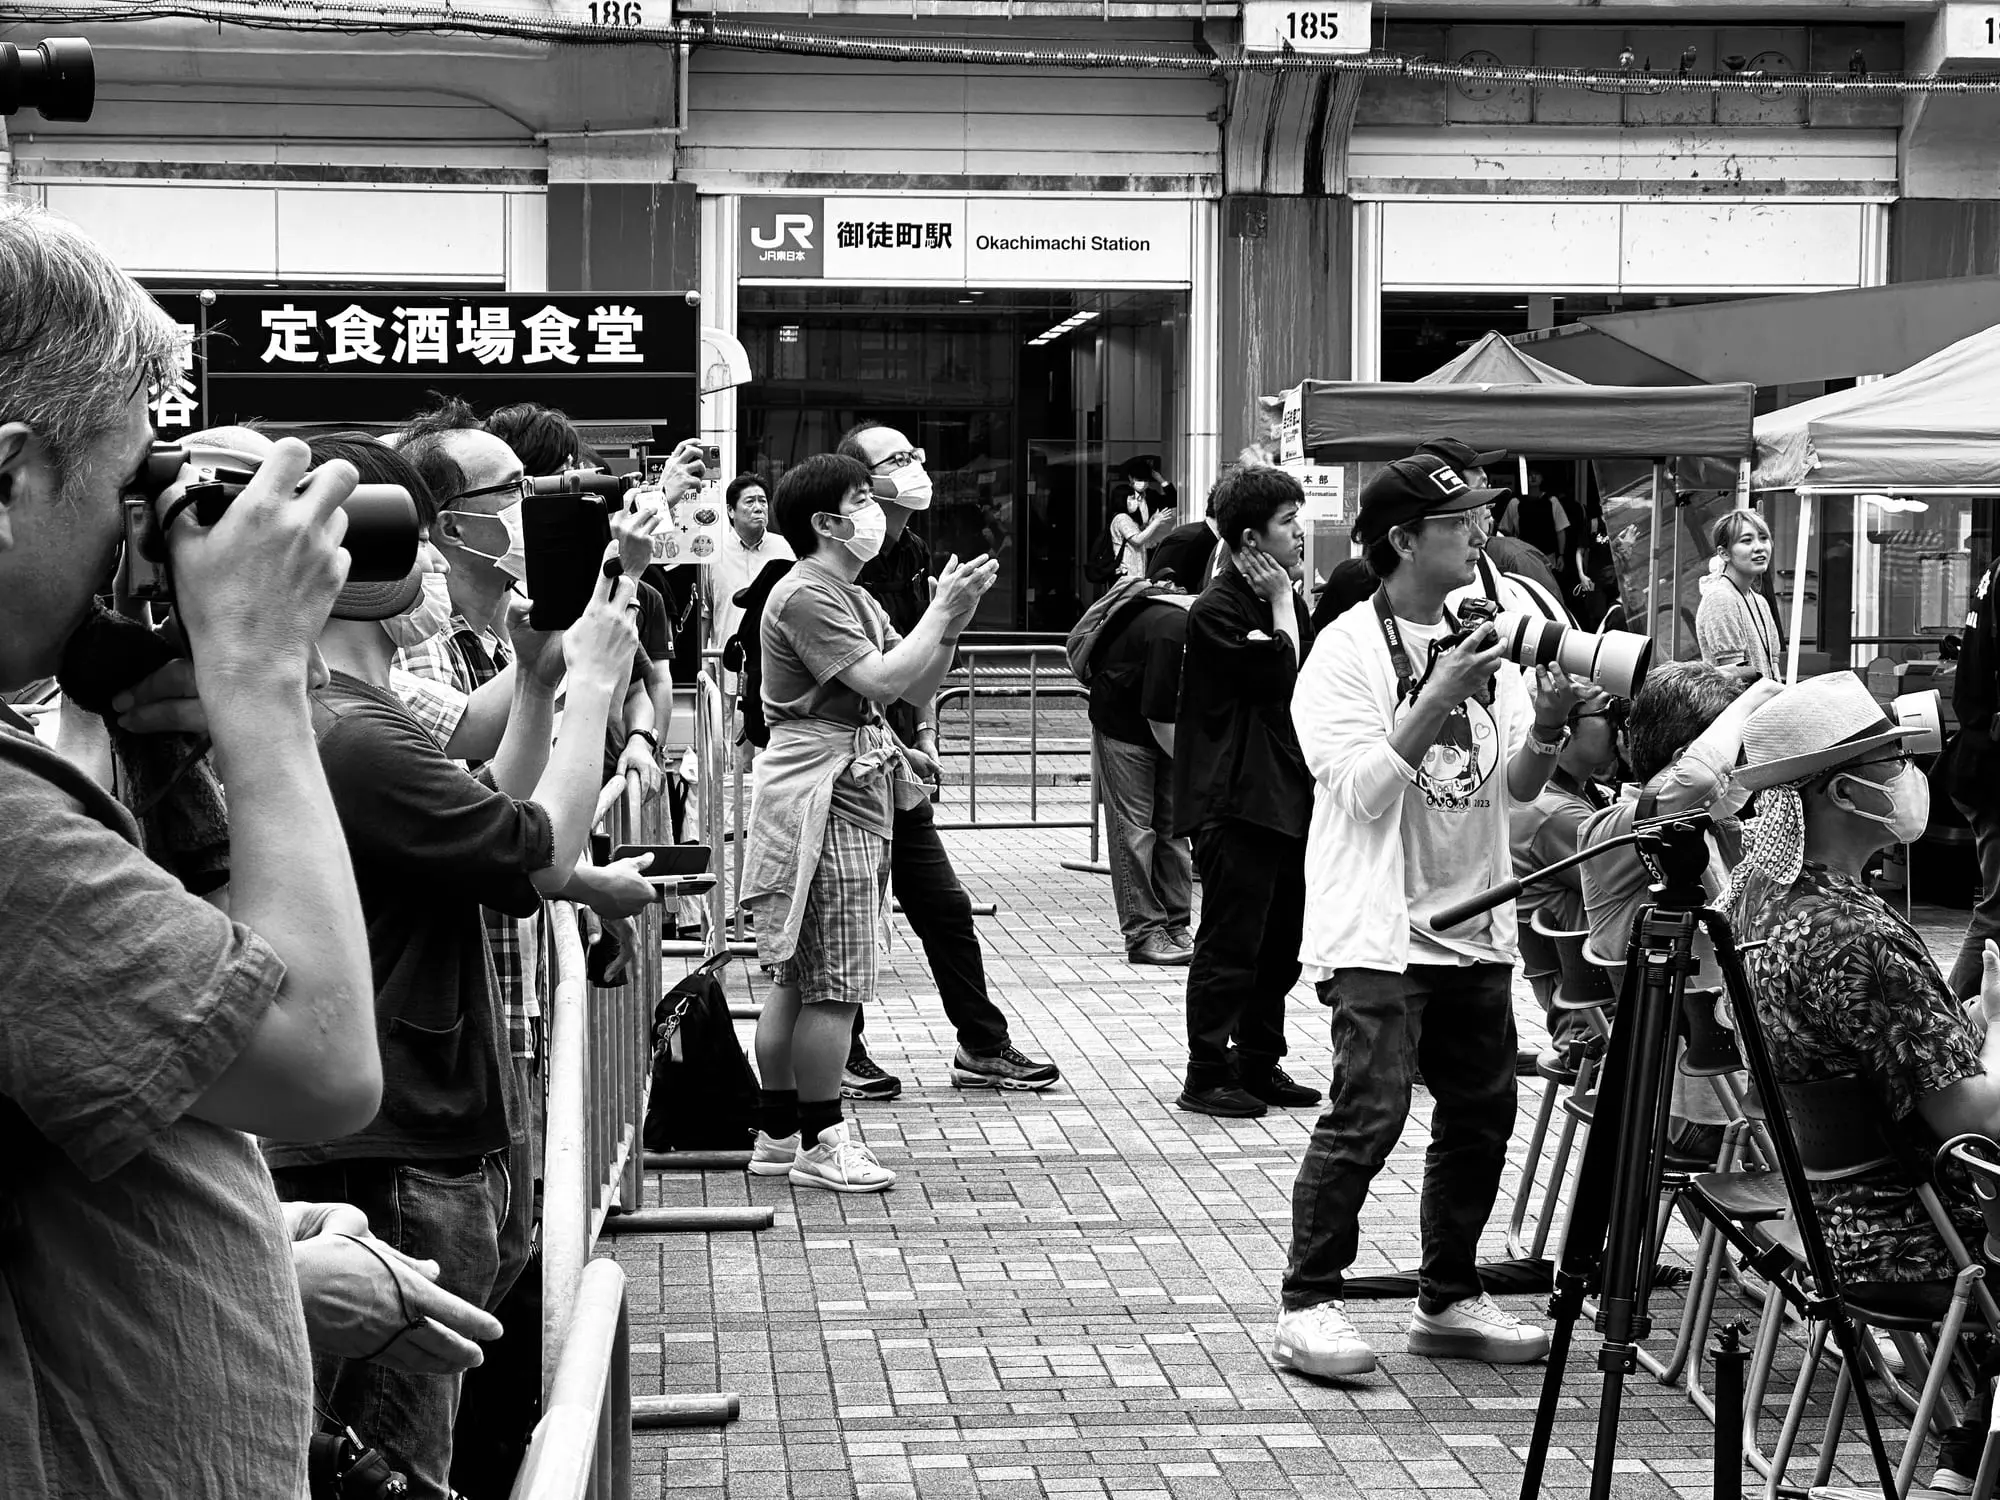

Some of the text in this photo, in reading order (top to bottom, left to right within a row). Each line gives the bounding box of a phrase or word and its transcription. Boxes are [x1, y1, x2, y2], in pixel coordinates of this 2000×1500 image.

[588, 1, 642, 26] 186
[1286, 12, 1338, 40] 185
[1985, 17, 2000, 44] 1
[751, 213, 814, 249] JR
[837, 221, 952, 249] 御徒町駅
[976, 235, 1150, 251] Okachimachi Station
[759, 250, 806, 262] JR東日本
[260, 304, 644, 365] 定食酒場食堂
[1384, 618, 1398, 646] Canon
